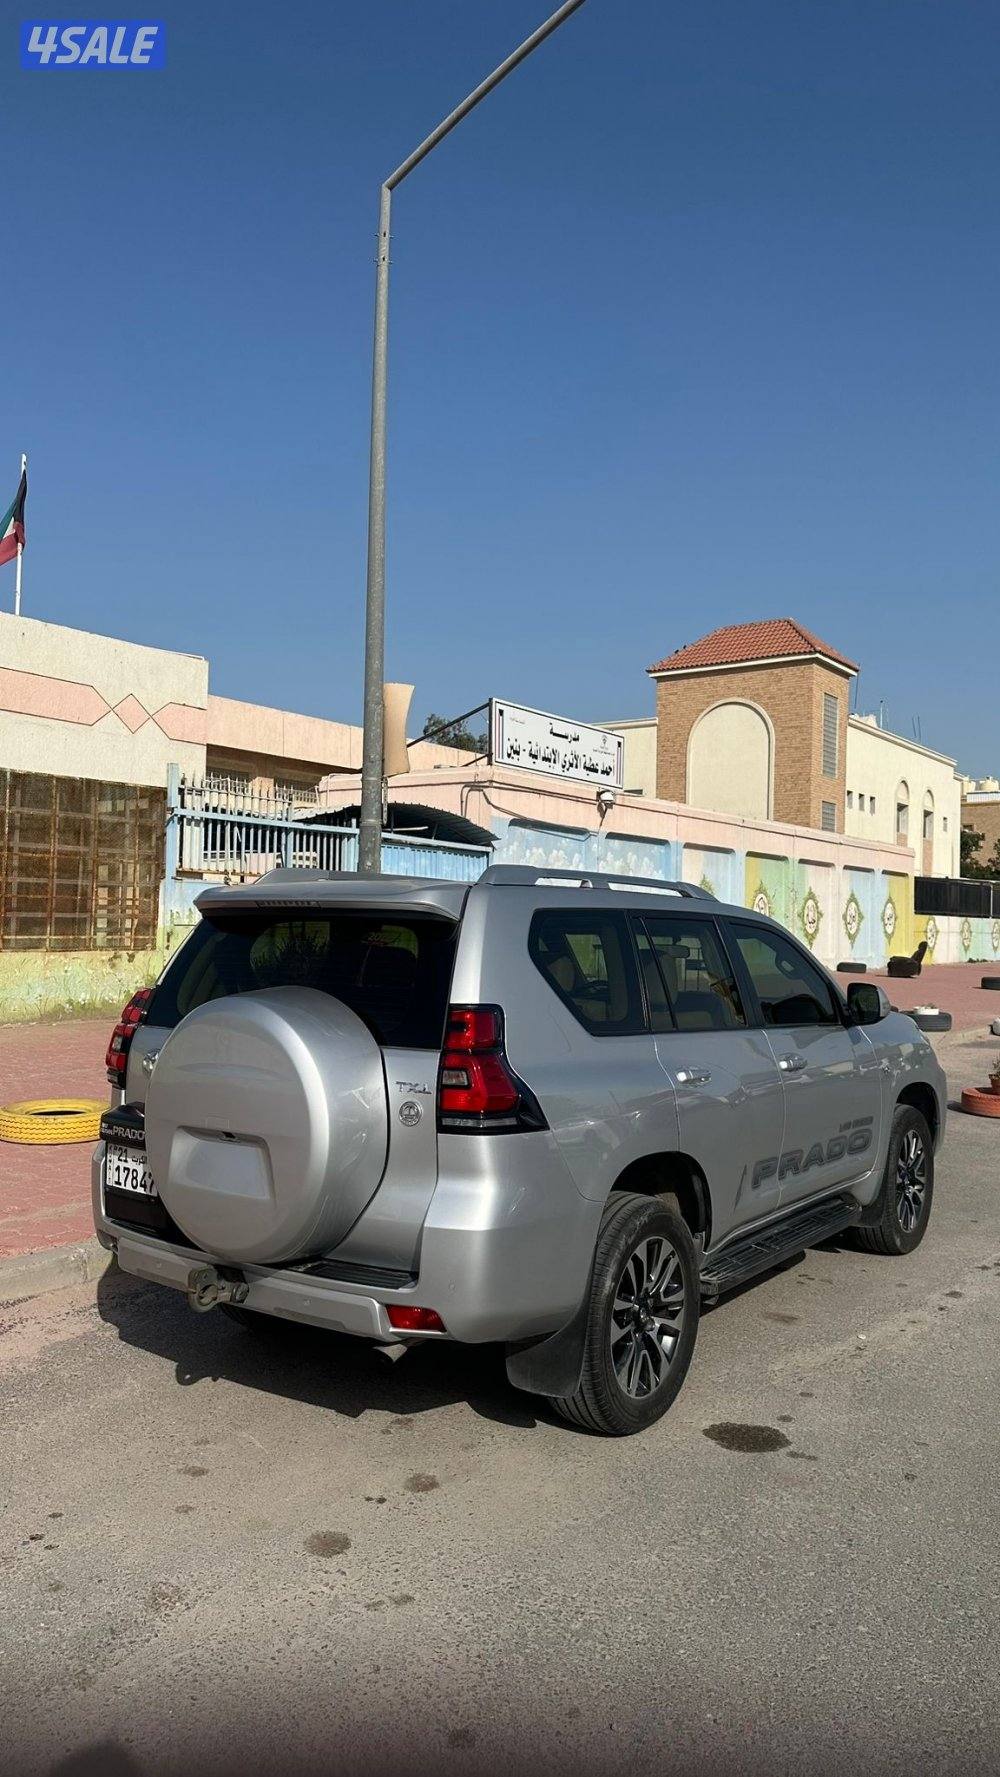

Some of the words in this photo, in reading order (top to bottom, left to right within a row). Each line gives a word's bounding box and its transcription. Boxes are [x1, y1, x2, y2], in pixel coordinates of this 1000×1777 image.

[549, 722, 580, 743] مدرسة
[506, 737, 521, 762] بنين
[113, 1125, 145, 1140] PRADO
[118, 1147, 128, 1163] 21
[752, 1128, 873, 1189] PRADO
